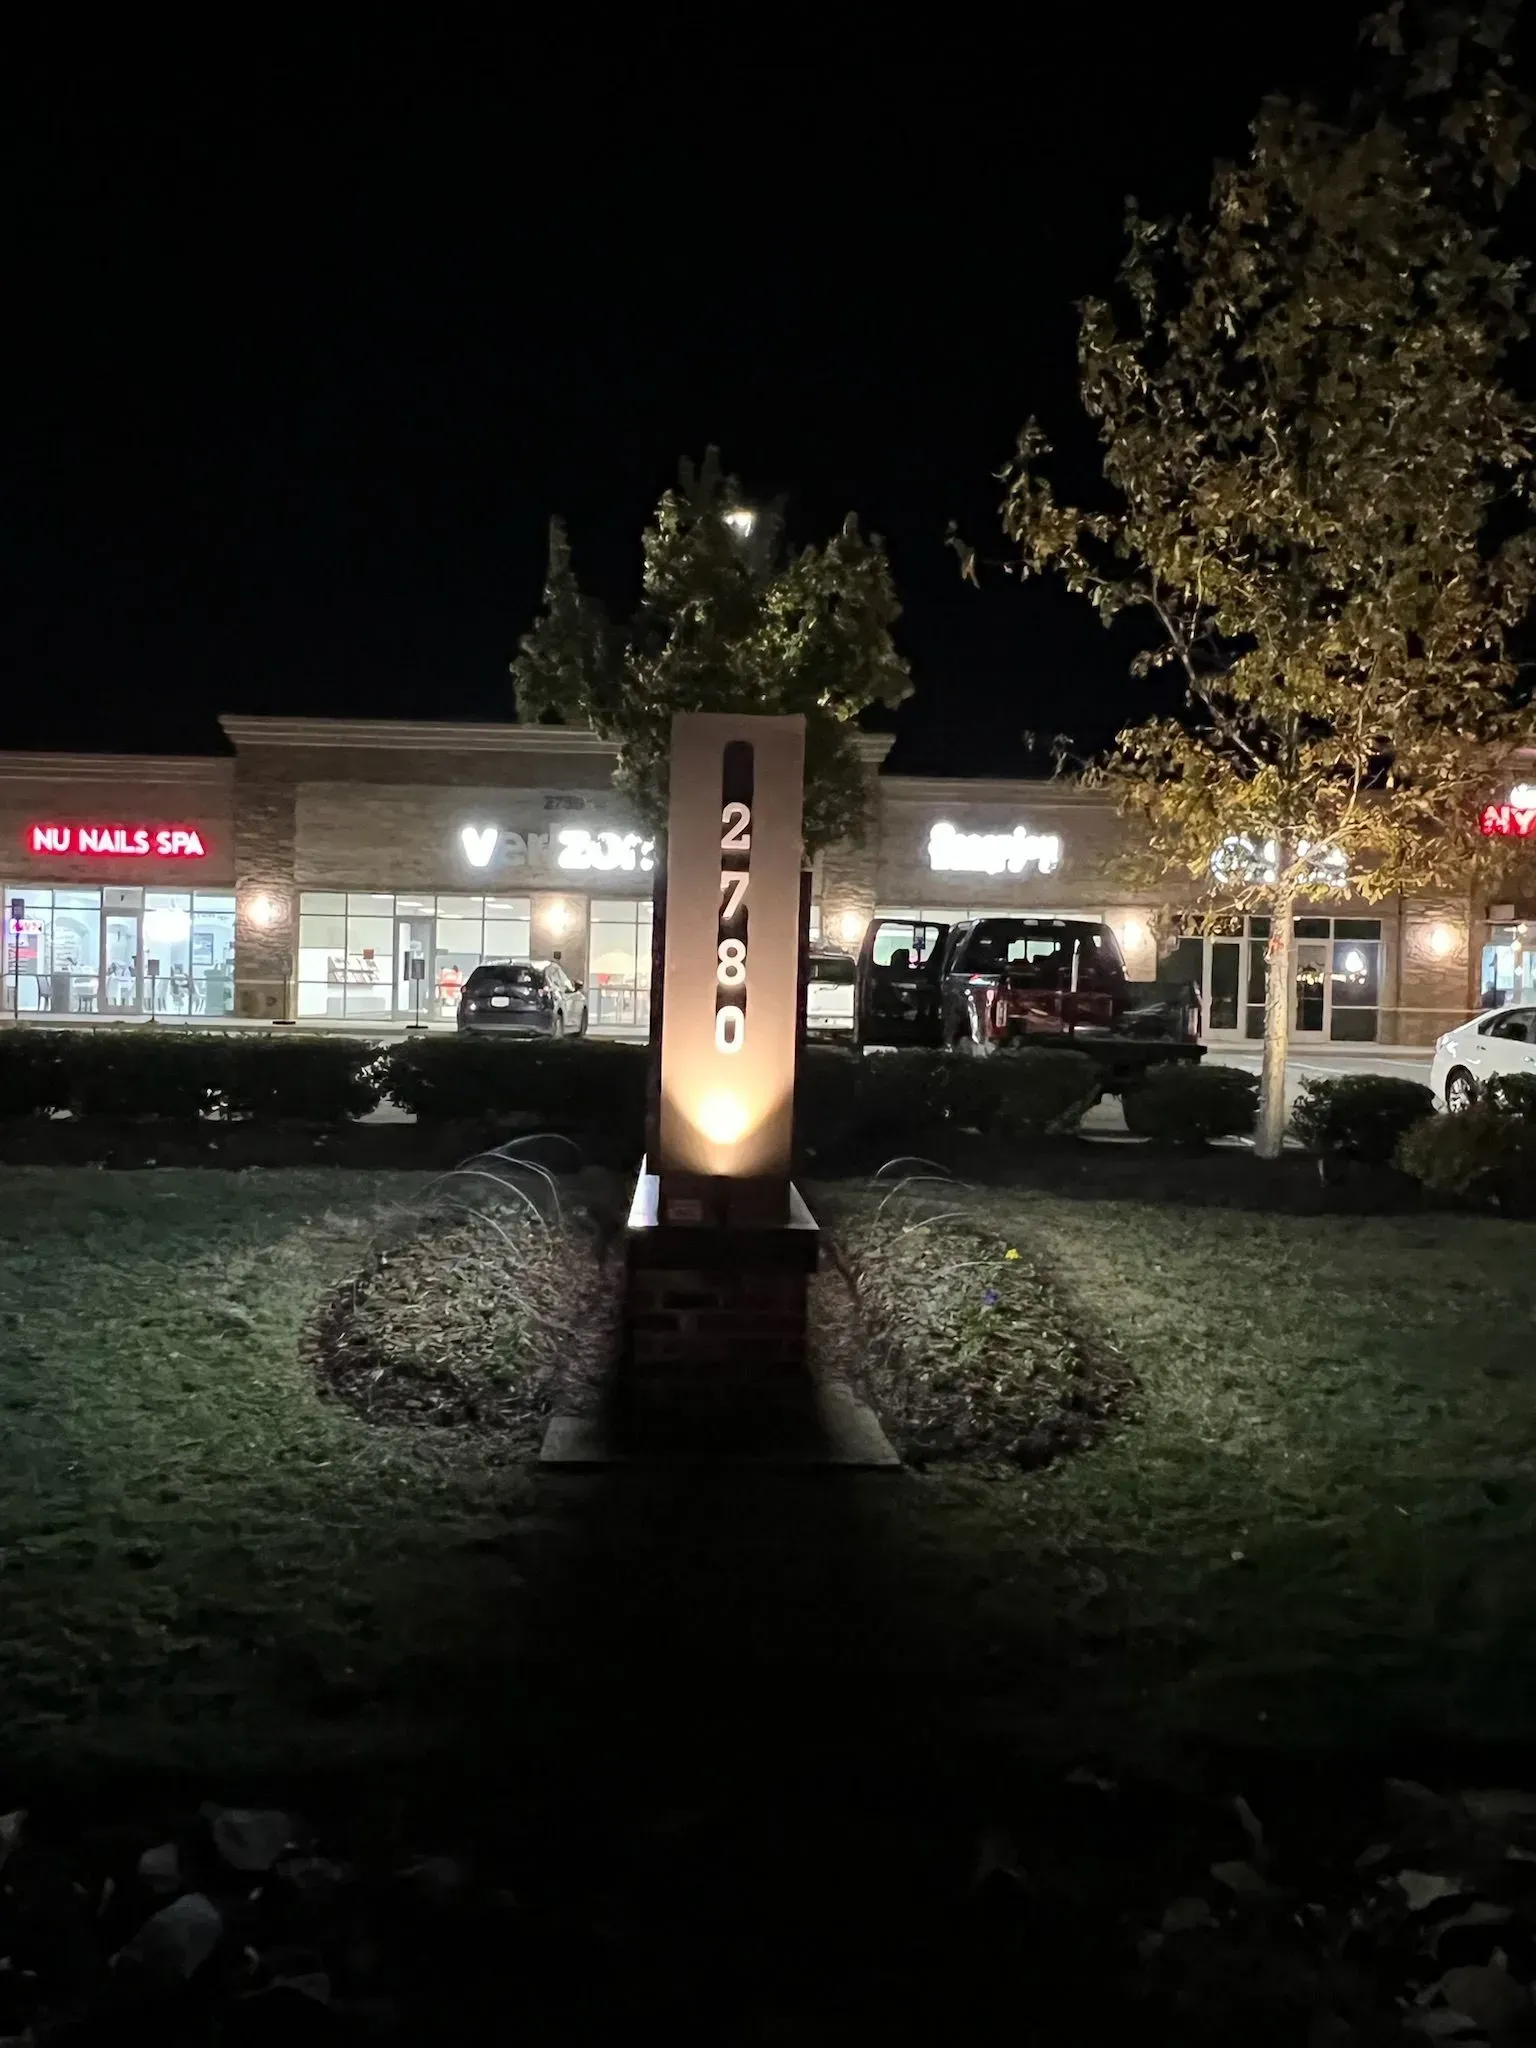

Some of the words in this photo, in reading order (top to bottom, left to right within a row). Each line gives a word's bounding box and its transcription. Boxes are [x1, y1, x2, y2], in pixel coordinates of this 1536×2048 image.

[33, 826, 71, 852] NU
[79, 828, 151, 855] NAILS
[156, 831, 205, 855] SPA
[715, 802, 751, 1055] 2780
